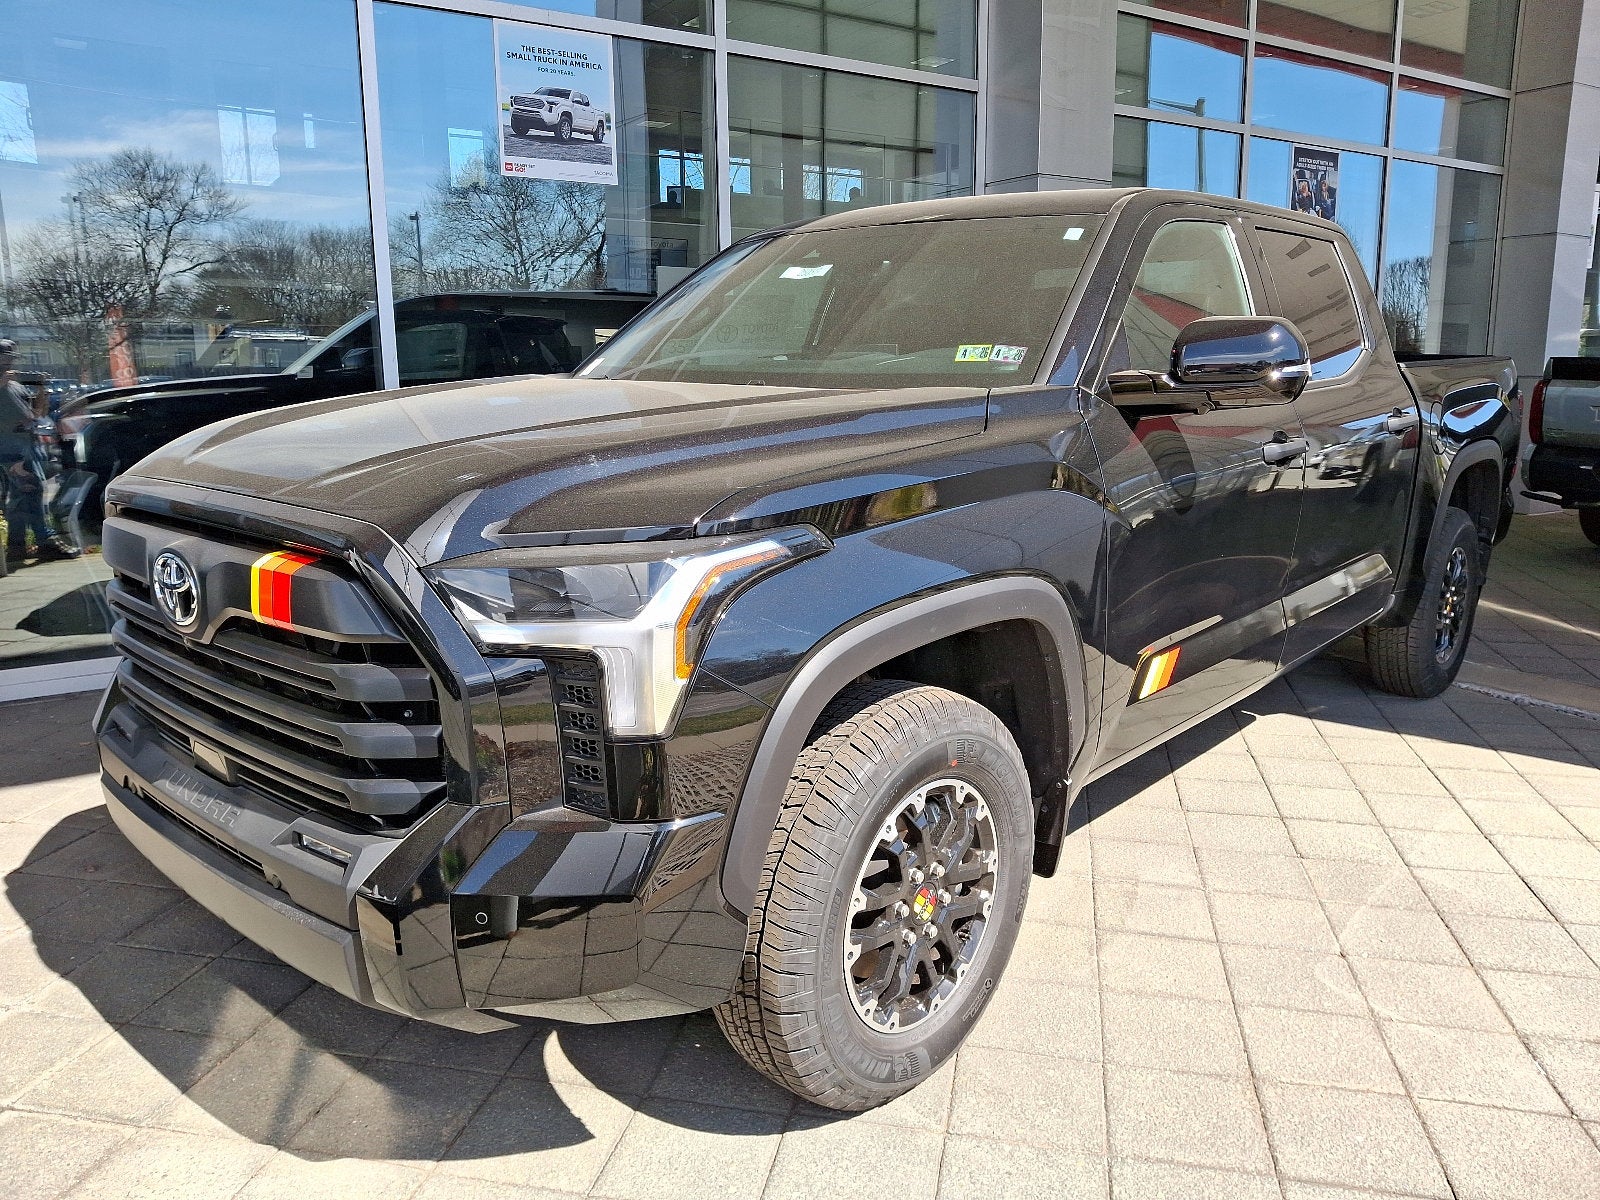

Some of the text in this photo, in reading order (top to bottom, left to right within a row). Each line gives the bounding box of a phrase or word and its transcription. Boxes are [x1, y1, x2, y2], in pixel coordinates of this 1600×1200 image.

[506, 51, 531, 61] SMALL
[533, 54, 558, 65] TRUCK
[569, 60, 603, 71] AMERICA
[521, 44, 588, 61] THE BEST-SELLING
[650, 239, 674, 249] Toyota
